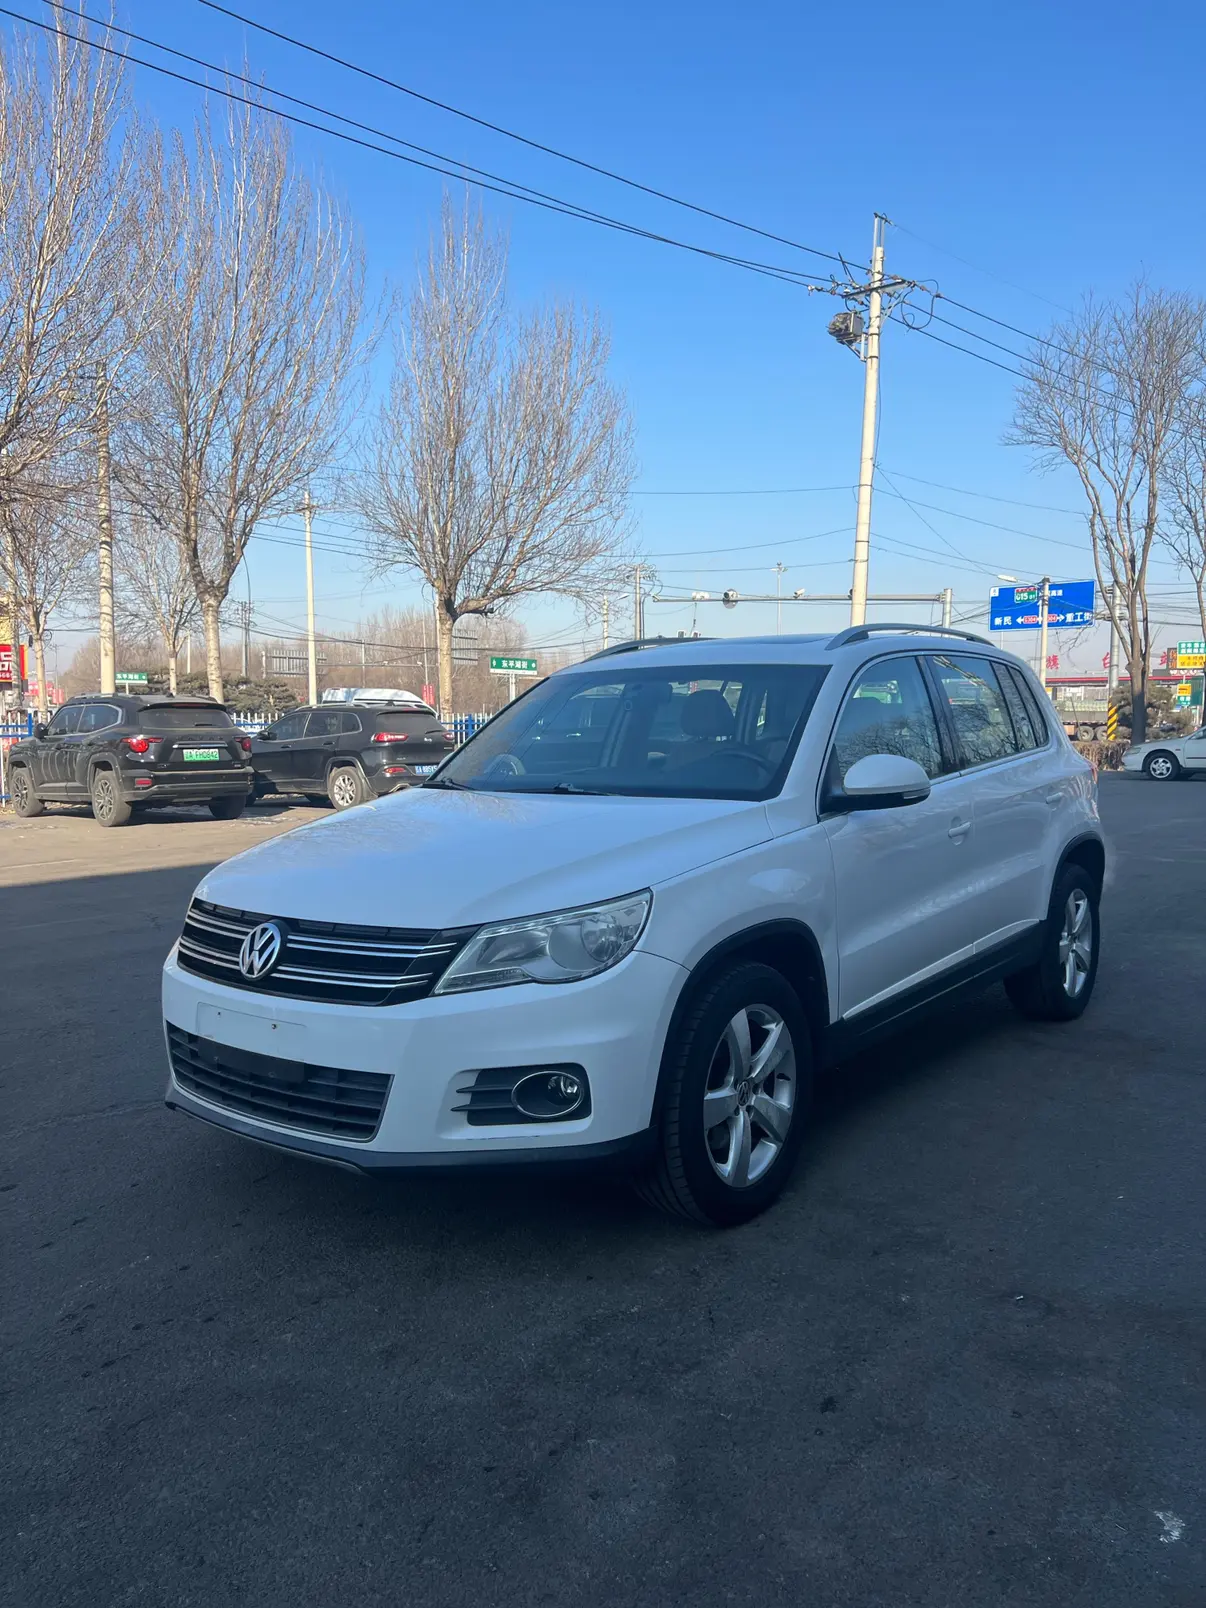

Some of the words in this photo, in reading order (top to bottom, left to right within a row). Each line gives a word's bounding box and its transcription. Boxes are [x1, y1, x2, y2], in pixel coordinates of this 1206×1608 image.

[994, 616, 1012, 626] 新民
[501, 659, 528, 669] 东平湖街
